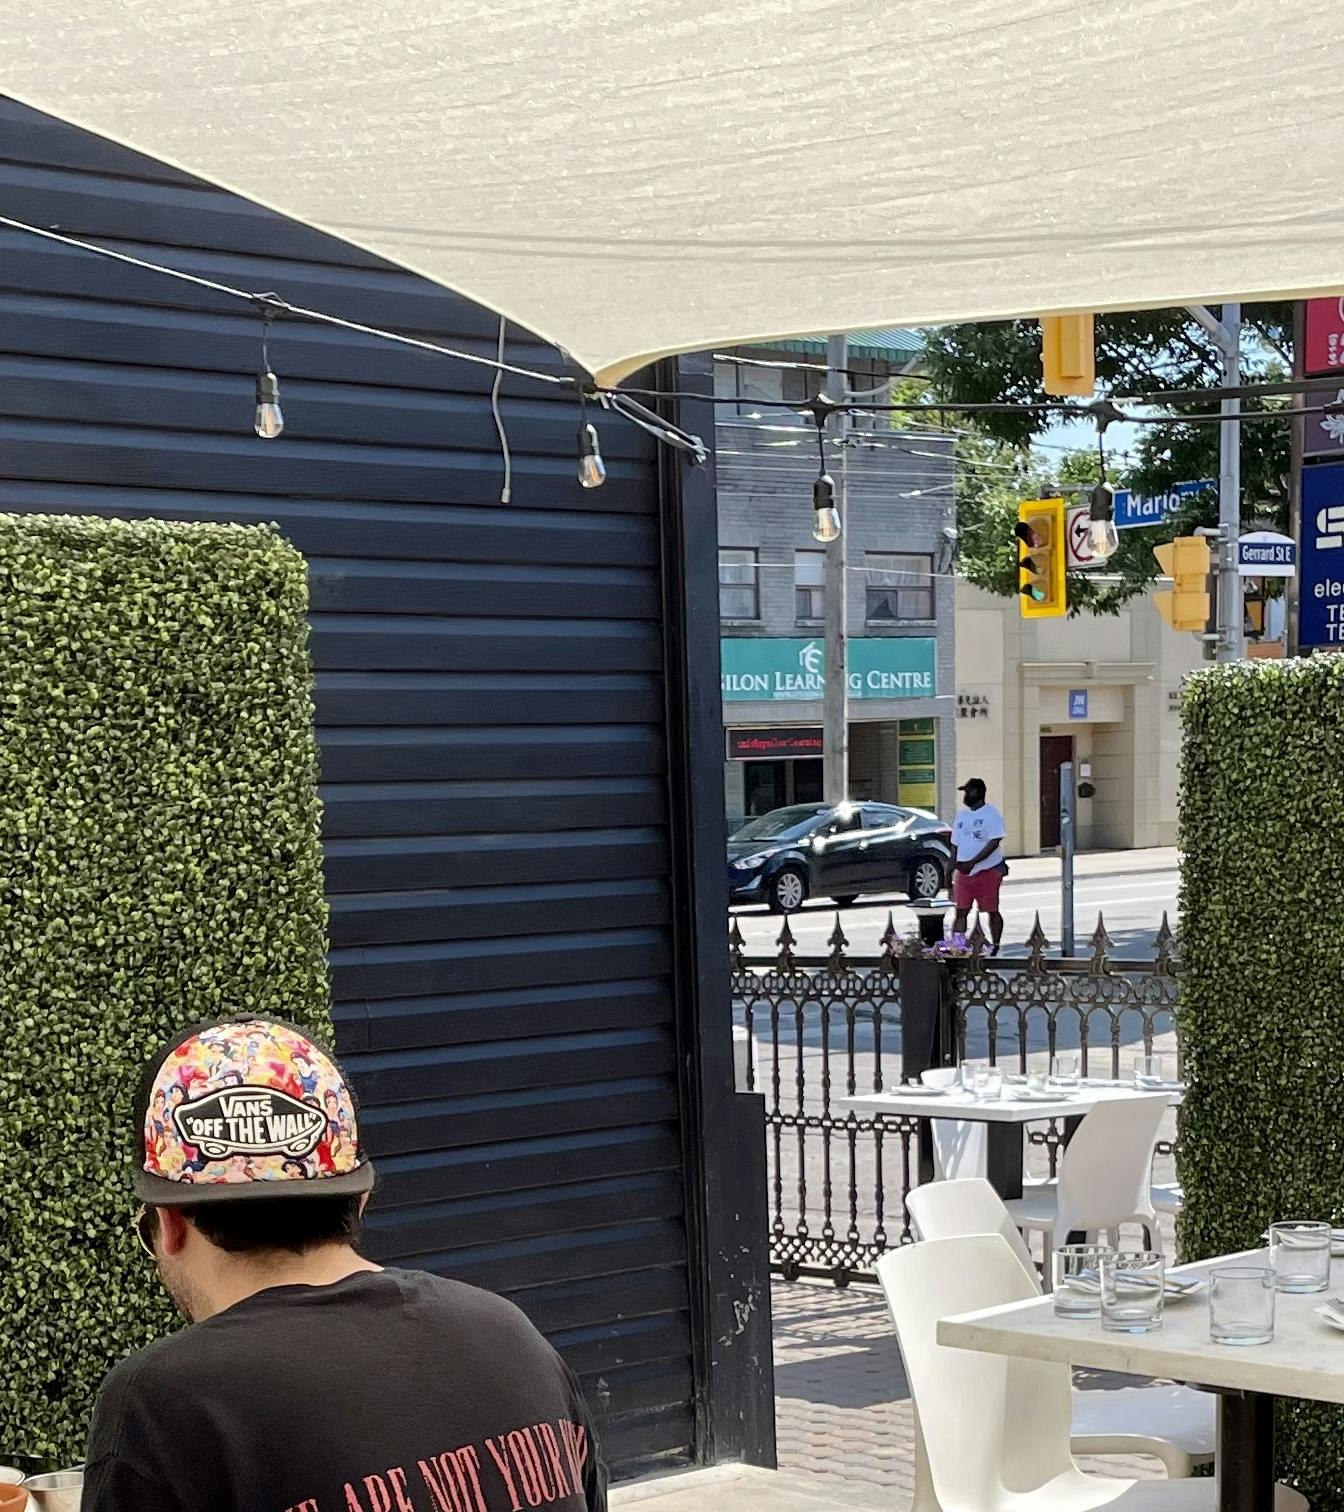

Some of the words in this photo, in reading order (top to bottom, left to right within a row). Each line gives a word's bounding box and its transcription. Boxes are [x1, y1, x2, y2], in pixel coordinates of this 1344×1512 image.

[1242, 545, 1274, 562] Gerrard
[1275, 546, 1285, 562] St
[1285, 546, 1292, 561] E
[774, 671, 862, 690] LEARNG
[866, 670, 932, 689] CENTRE
[219, 1095, 272, 1116] VANS
[225, 1117, 264, 1144] THE
[485, 1422, 571, 1512] YOUR
